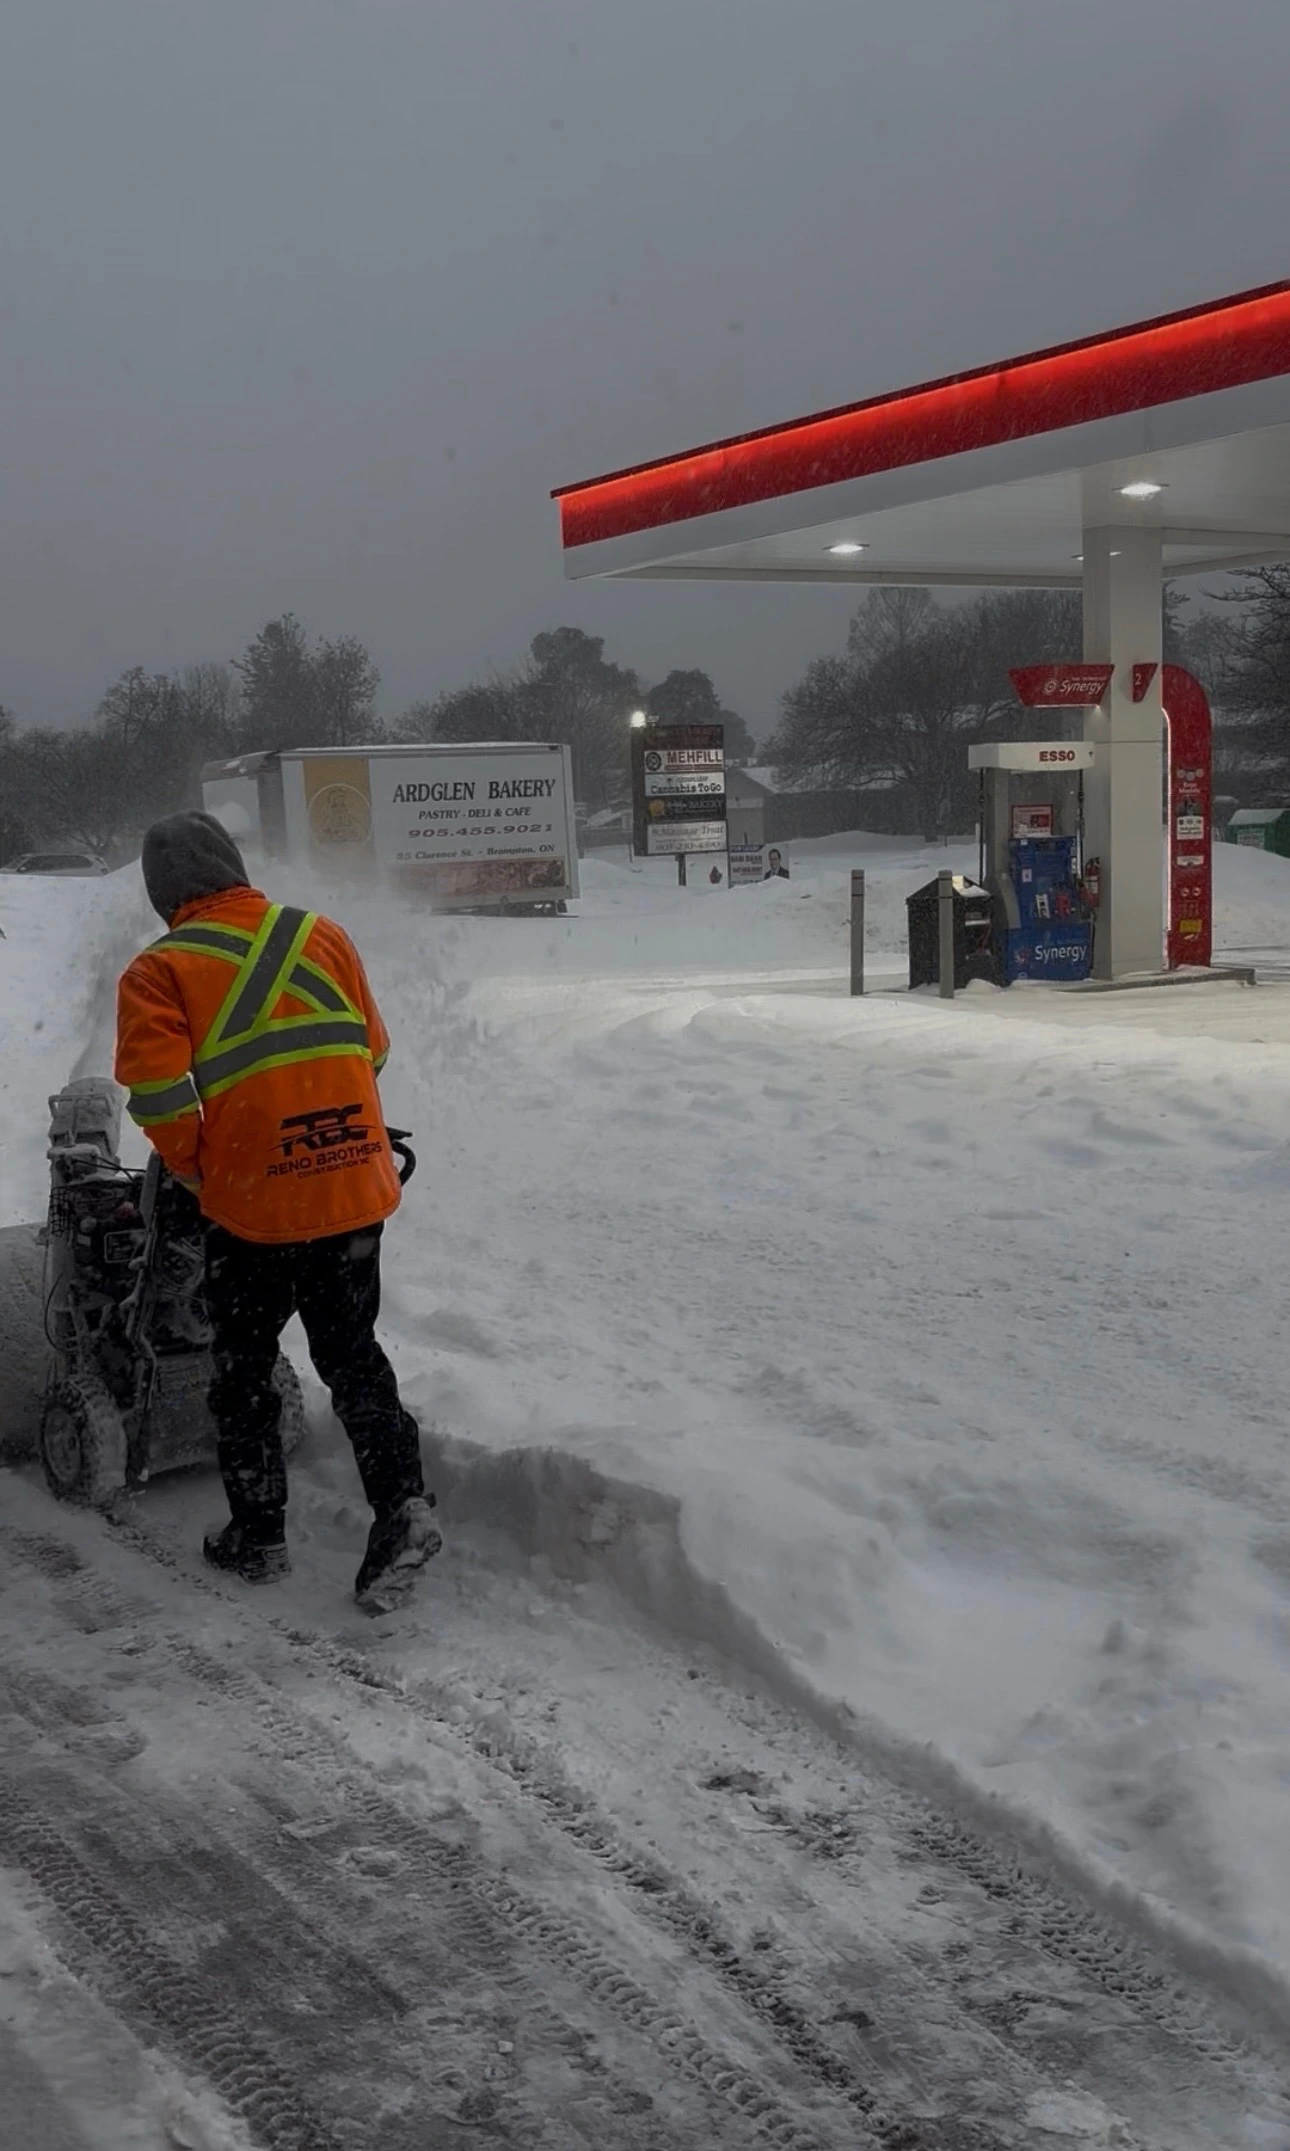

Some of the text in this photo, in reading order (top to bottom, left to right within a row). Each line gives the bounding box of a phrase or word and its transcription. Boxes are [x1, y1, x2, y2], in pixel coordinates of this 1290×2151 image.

[1134, 673, 1142, 685] 2
[1060, 680, 1106, 695] Synergy
[667, 751, 723, 764] MEHFILL
[1039, 750, 1076, 762] ESSO
[393, 779, 556, 802] ARDGLEN BAKERY
[651, 783, 697, 795] Cannabis
[418, 809, 461, 820] PASTRY
[468, 808, 491, 818] DELI
[493, 807, 502, 817] &
[505, 806, 531, 817] CAFE
[408, 823, 553, 839] 905.455.9021
[415, 850, 457, 860] Clarence
[539, 844, 555, 853] ON
[1034, 944, 1088, 965] Synergy
[266, 1141, 383, 1178] RENO BROTHERS
